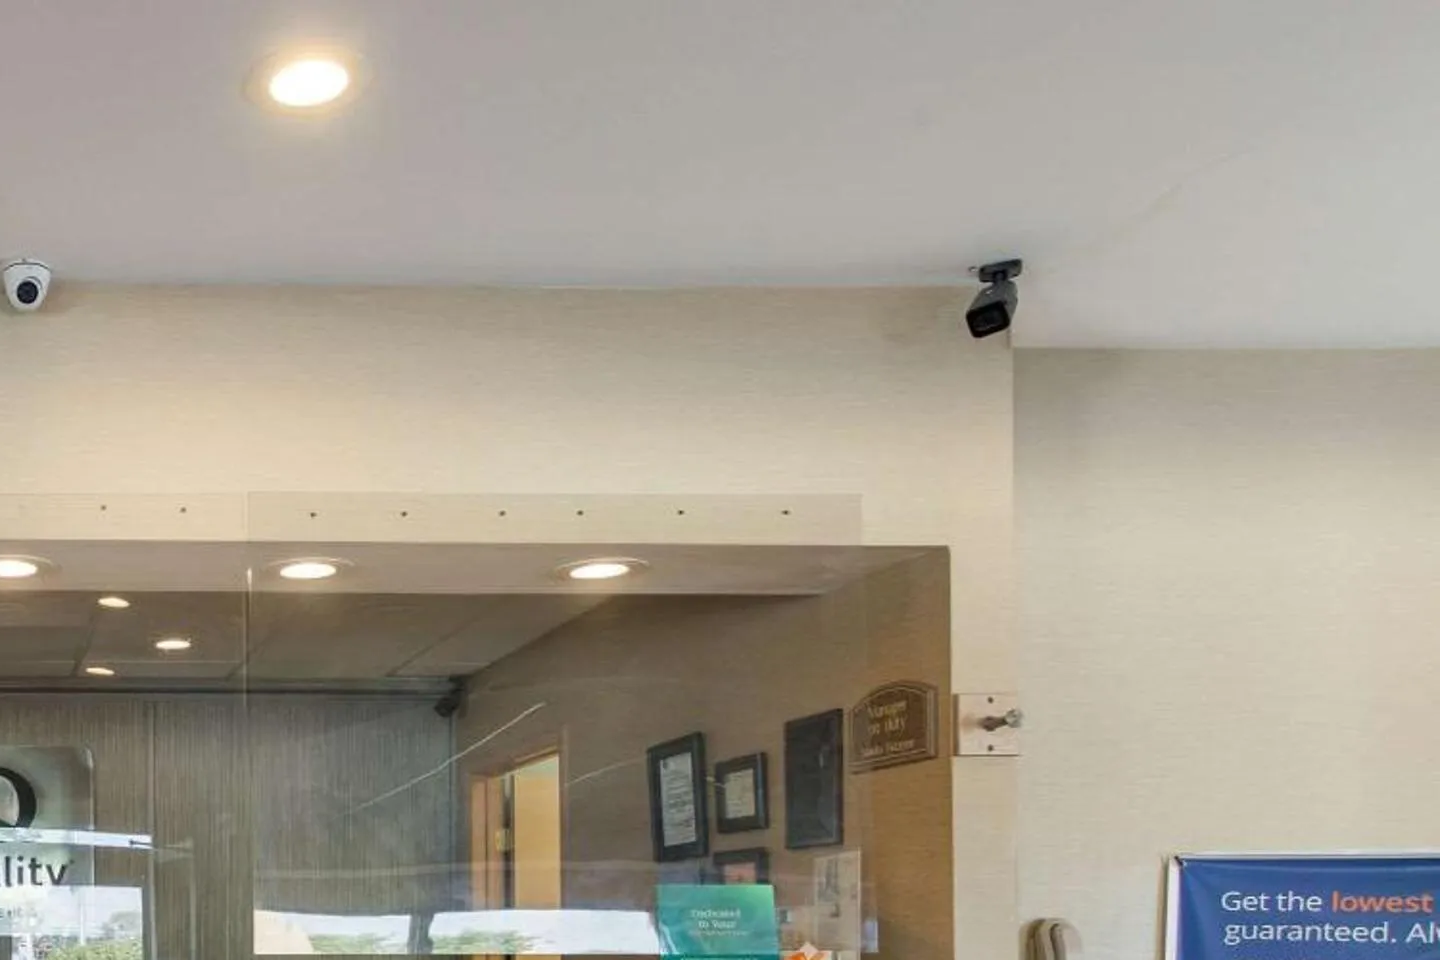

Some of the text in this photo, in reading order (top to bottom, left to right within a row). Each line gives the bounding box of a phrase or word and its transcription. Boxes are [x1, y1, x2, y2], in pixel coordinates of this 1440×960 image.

[1221, 890, 1434, 913] Get the lowest
[1223, 921, 1397, 945] guaranteed.
